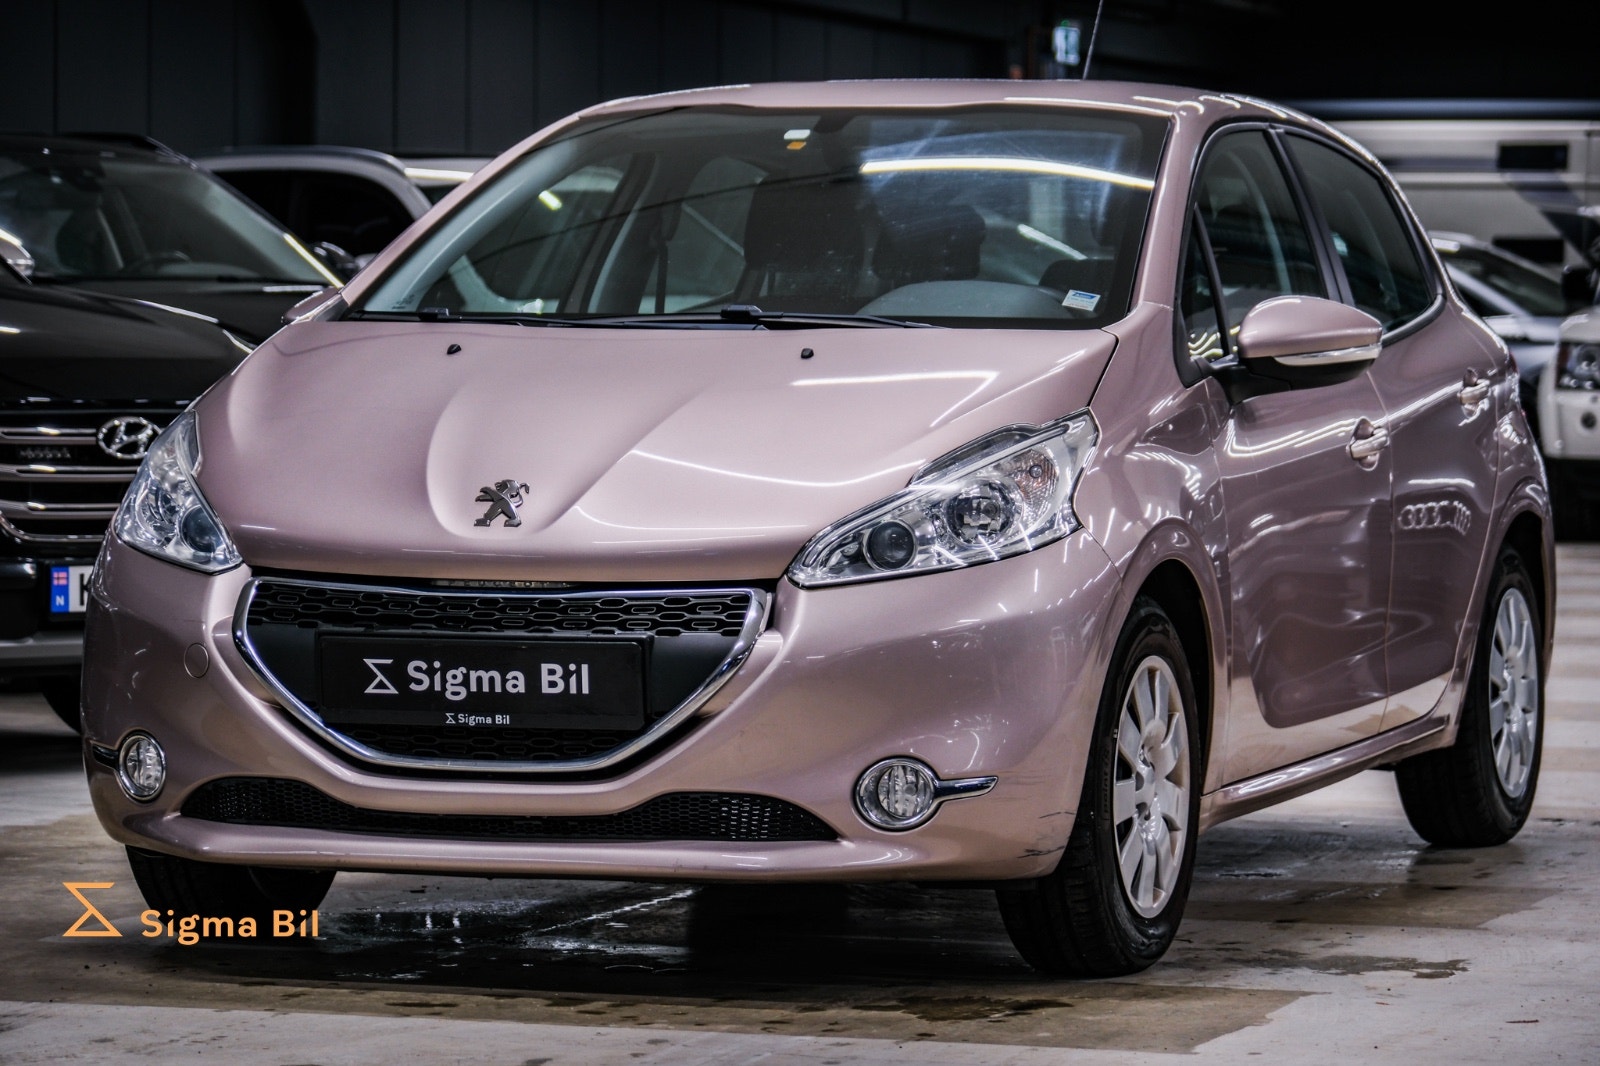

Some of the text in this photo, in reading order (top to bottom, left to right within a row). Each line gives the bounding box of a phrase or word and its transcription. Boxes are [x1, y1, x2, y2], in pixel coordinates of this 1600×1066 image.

[55, 595, 65, 606] N
[407, 660, 590, 701] Sigma Bil
[457, 713, 510, 726] Sigma Bil
